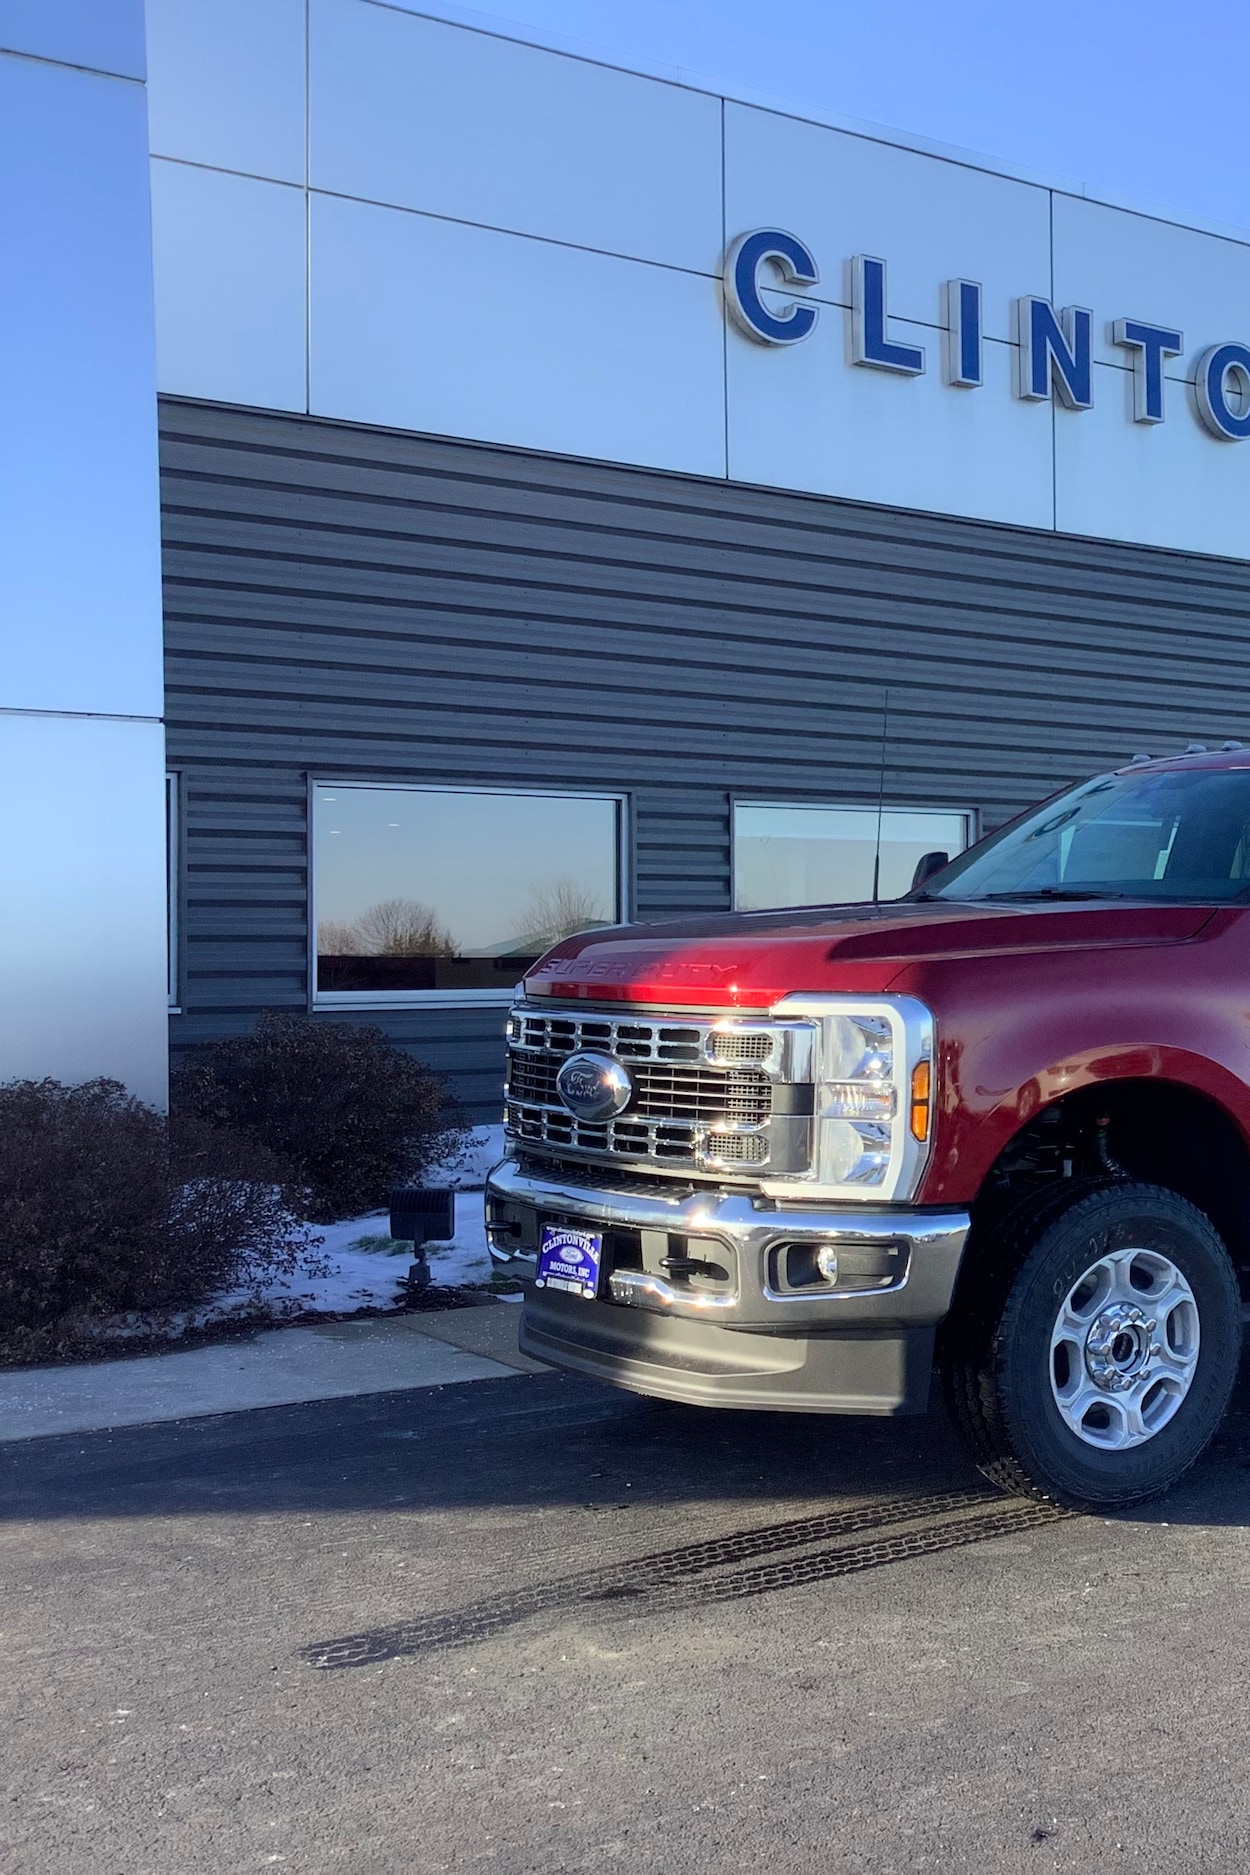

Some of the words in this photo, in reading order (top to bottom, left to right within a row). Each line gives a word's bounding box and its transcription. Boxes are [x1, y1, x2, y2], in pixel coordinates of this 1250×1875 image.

[539, 958, 631, 978] SUPER
[633, 961, 738, 980] DUTY
[567, 1070, 601, 1100] Ford
[542, 1233, 600, 1265] CLINTONVILLE
[577, 1266, 590, 1278] INC
